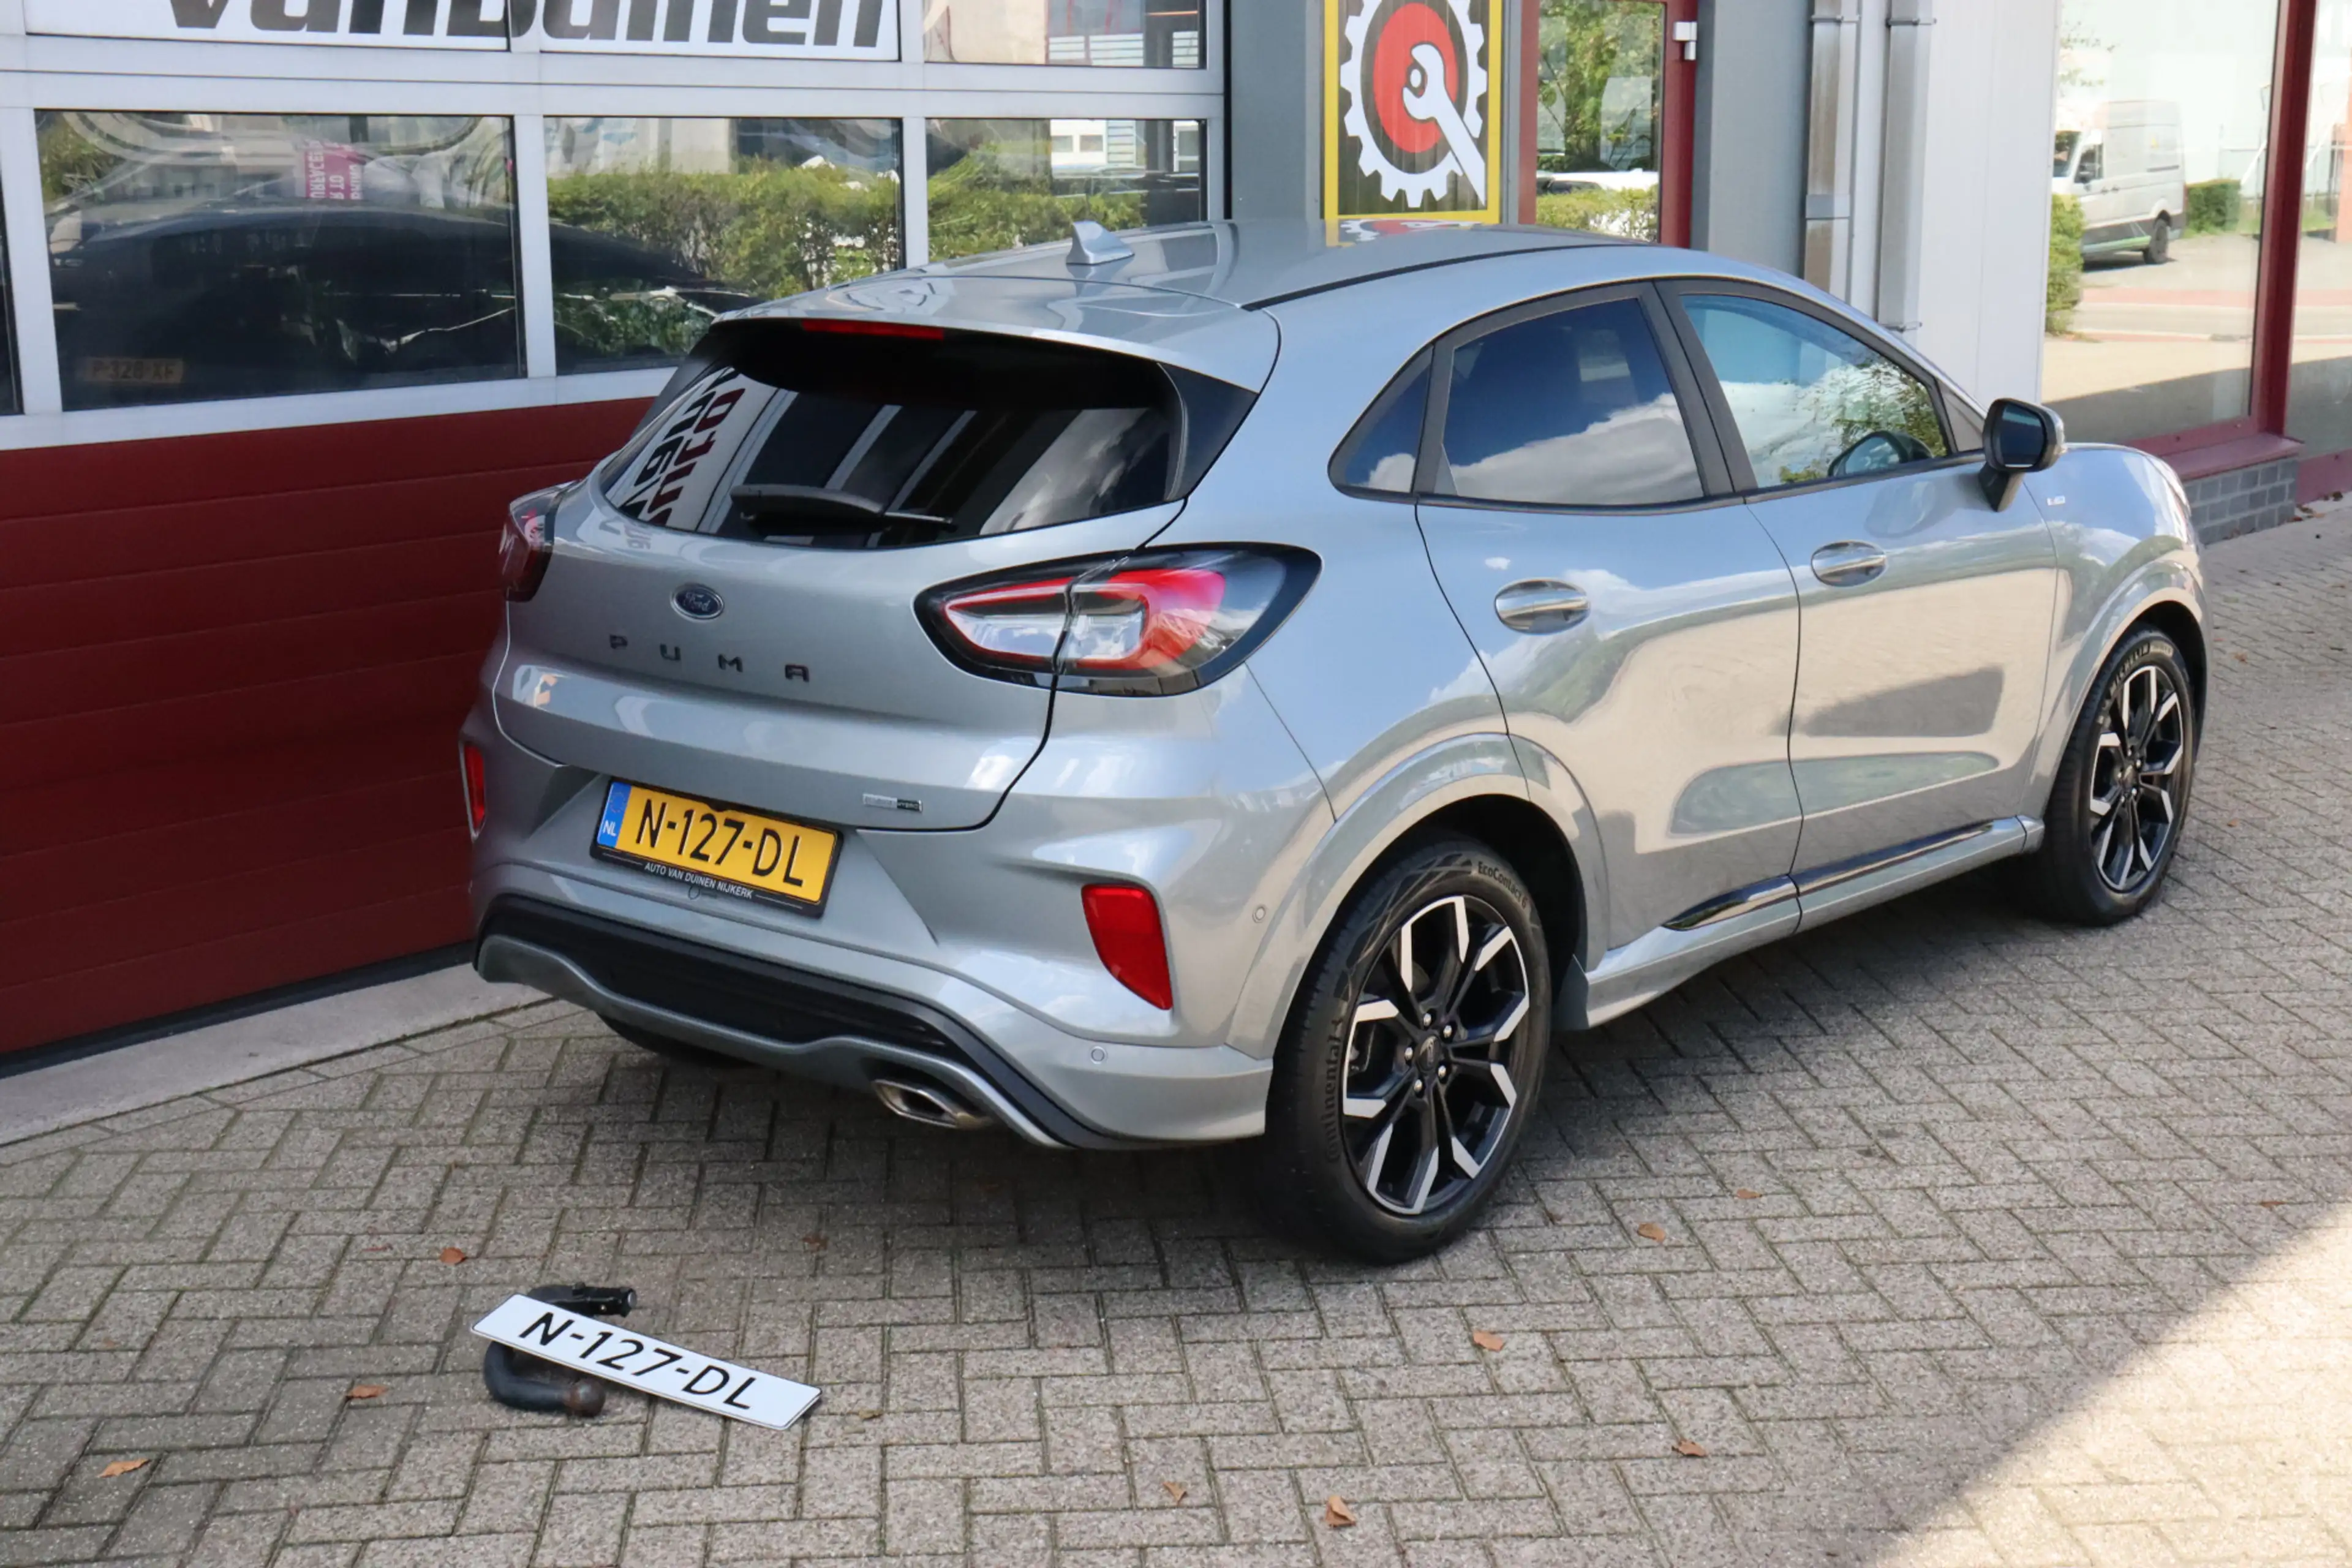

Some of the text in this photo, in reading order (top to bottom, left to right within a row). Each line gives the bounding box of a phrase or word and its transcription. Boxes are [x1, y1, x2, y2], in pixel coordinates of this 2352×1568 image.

[609, 633, 810, 682] PUMA
[602, 798, 804, 888] NL N-127-DL
[644, 862, 754, 899] AUTO VAN DUINEN NIJKERK
[1477, 860, 1529, 910] EcoContact 6
[1321, 1034, 1341, 1163] Continental
[518, 1311, 757, 1410] N-127-DL
